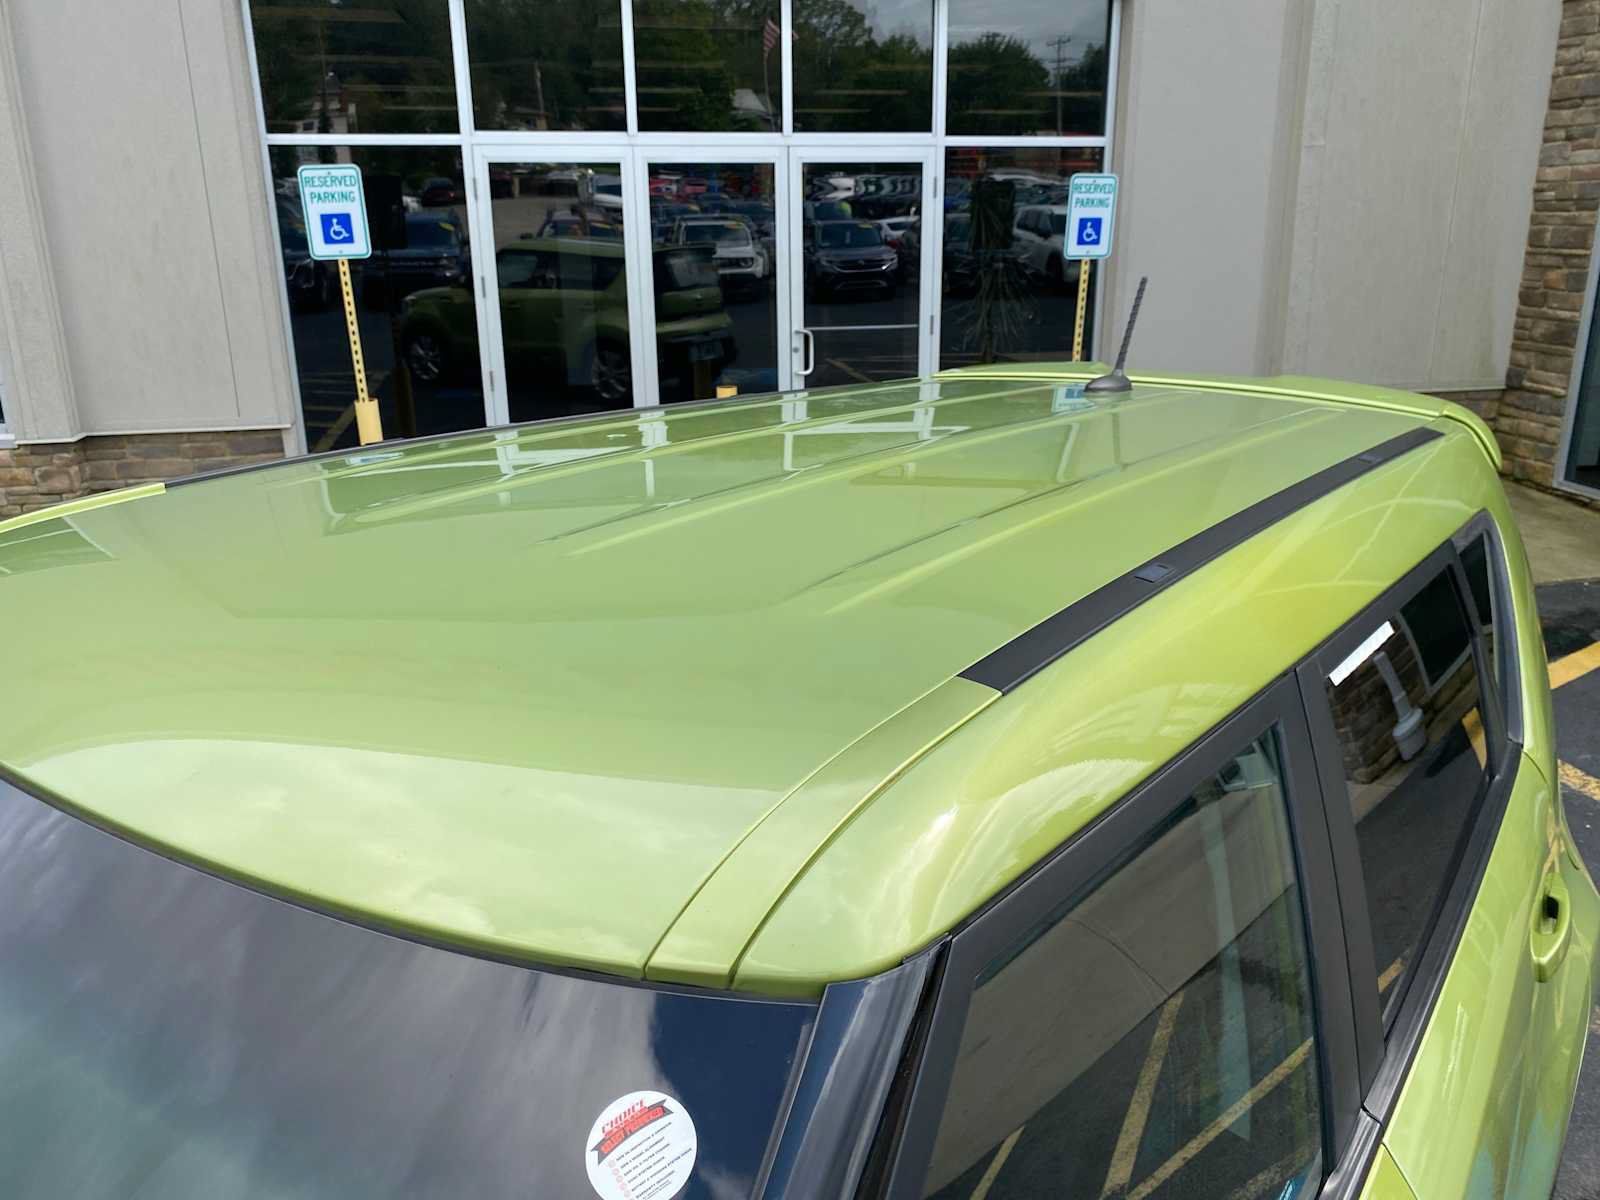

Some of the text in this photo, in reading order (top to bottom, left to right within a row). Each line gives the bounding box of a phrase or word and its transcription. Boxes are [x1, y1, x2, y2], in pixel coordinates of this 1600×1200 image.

[303, 175, 357, 188] RESERVED
[1072, 183, 1115, 194] RESERVED
[310, 191, 356, 204] PARKING
[1074, 197, 1110, 208] PARKING
